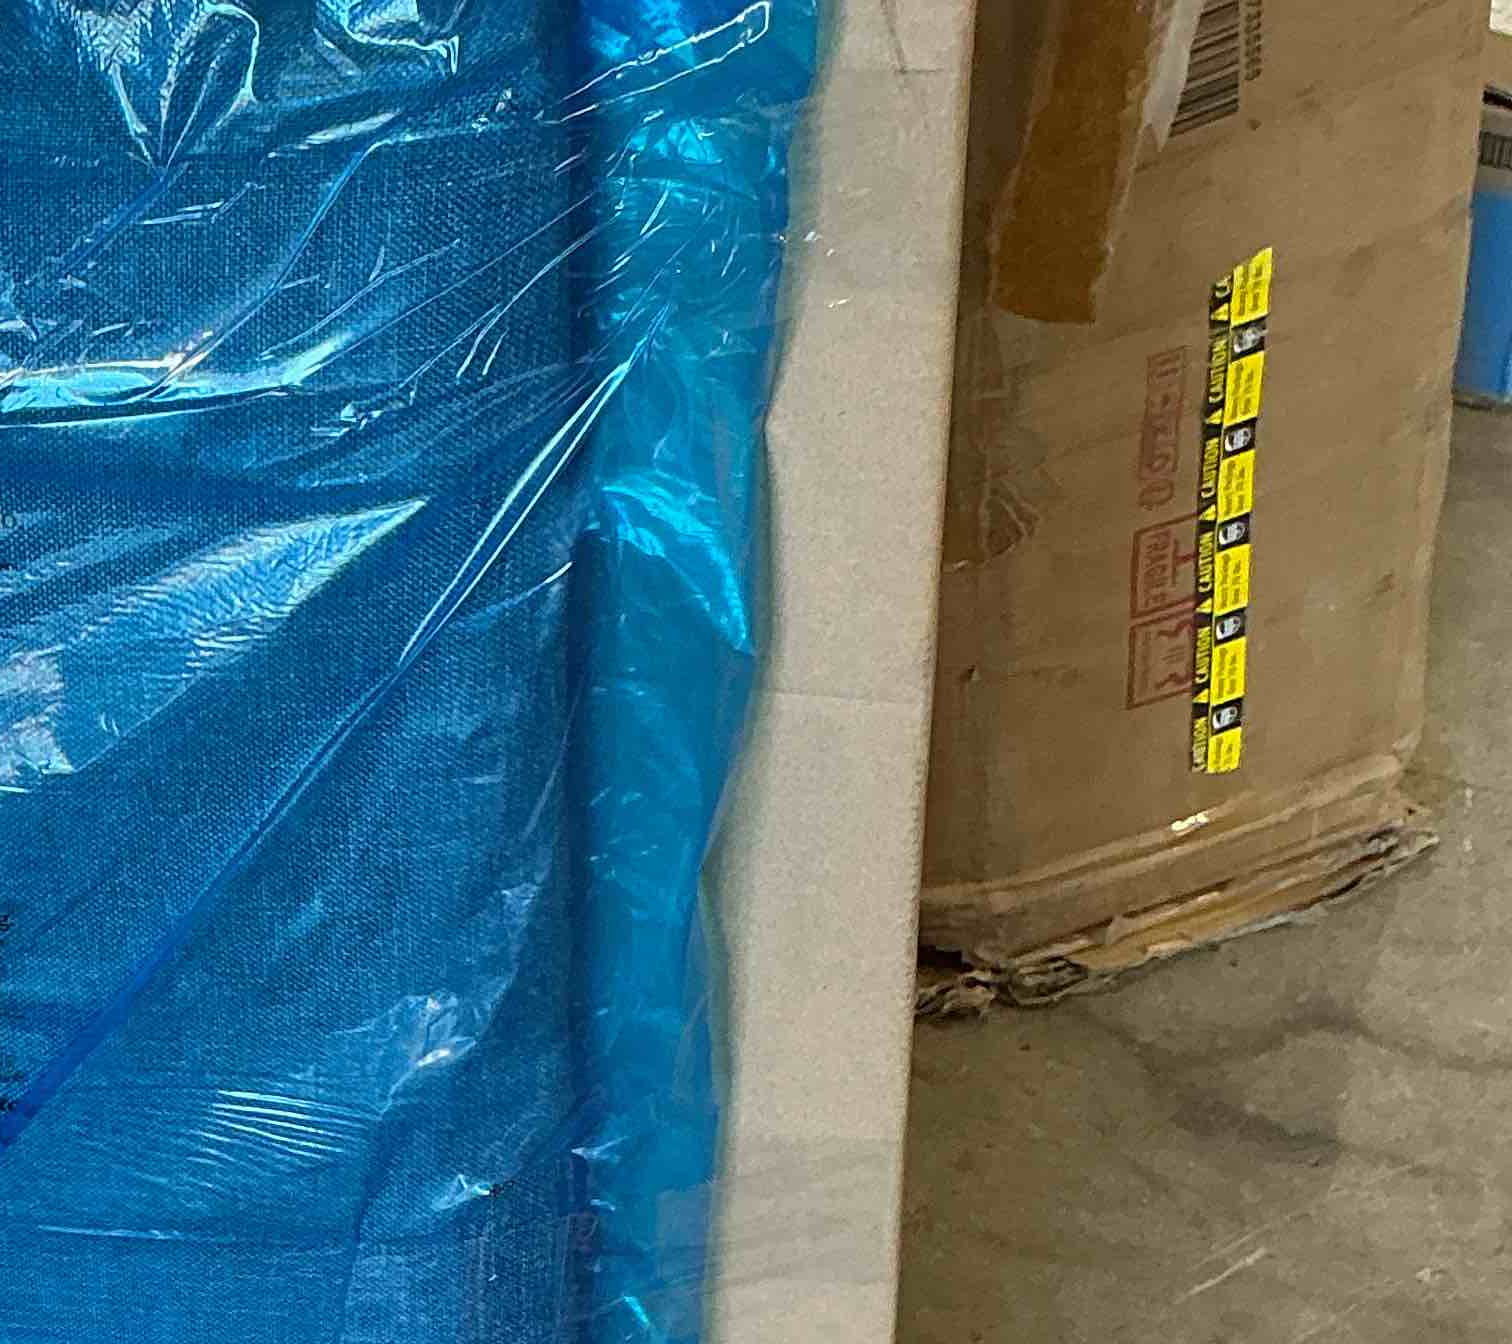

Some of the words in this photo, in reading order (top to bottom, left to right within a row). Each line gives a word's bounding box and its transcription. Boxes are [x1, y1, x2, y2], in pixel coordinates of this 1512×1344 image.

[1207, 339, 1227, 403] CAUTION
[1201, 438, 1220, 498] CAUTION
[1198, 530, 1215, 593] CAUTION
[1195, 625, 1211, 684] CAUTION
